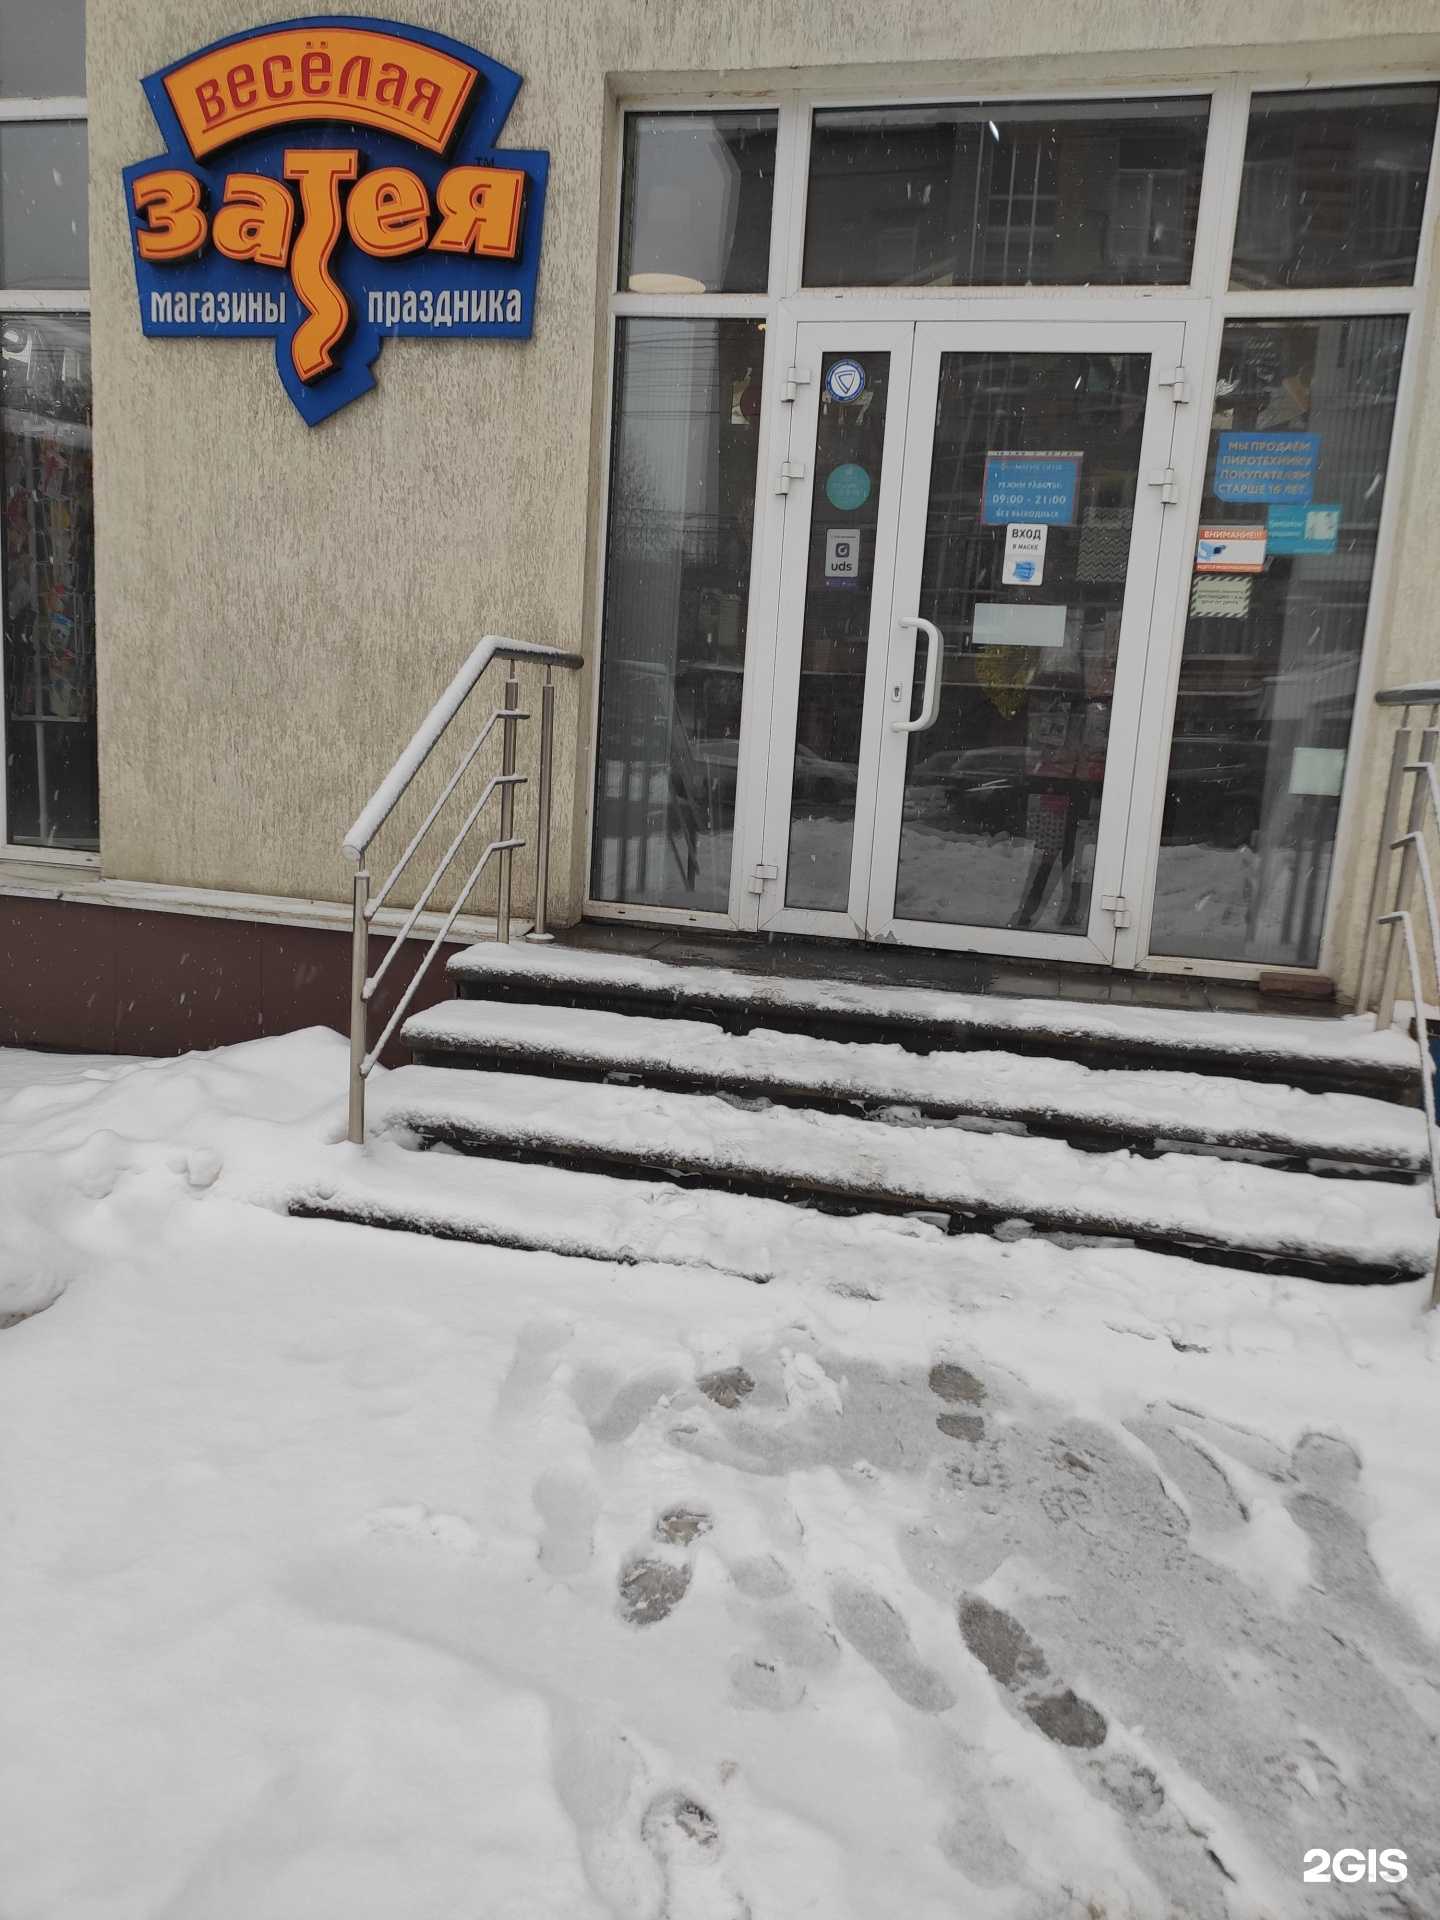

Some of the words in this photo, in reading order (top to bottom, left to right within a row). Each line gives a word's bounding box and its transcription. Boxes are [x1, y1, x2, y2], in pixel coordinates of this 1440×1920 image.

[151, 291, 286, 323] магазины
[368, 288, 522, 327] праздника
[1219, 484, 1264, 495] СТАРШЕ
[992, 495, 1024, 504] 09:00
[1035, 496, 1066, 505] 21:00
[1012, 529, 1041, 540] ВХОД
[831, 562, 853, 571] uds
